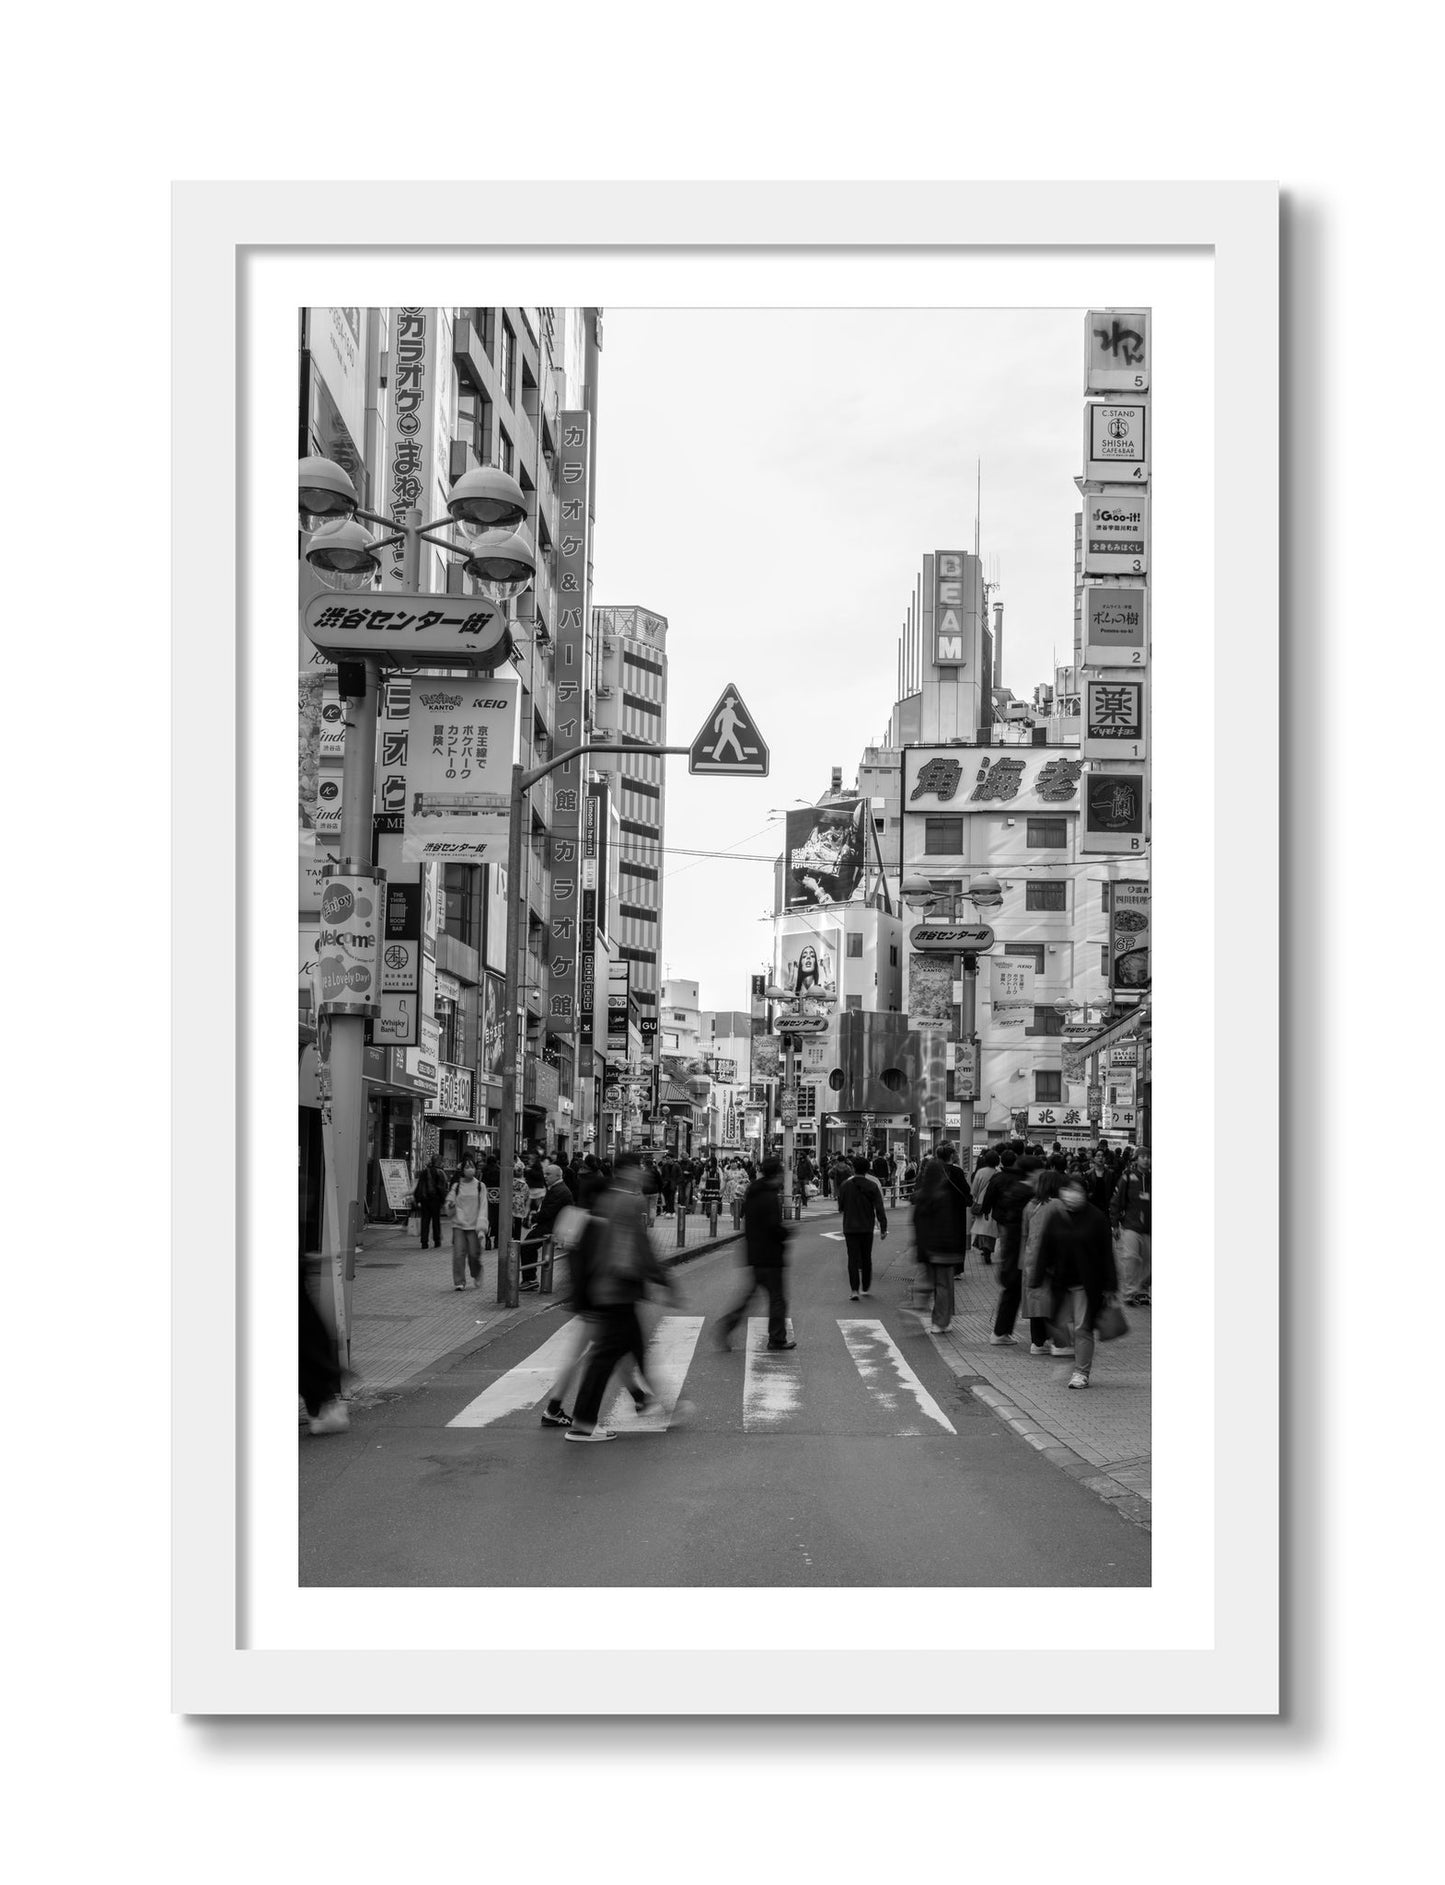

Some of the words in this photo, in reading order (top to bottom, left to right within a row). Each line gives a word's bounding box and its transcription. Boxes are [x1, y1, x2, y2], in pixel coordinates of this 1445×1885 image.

[1134, 376, 1144, 386] 5
[1102, 439, 1134, 448] SHISHA
[1101, 510, 1140, 522] Goo-it!
[1093, 543, 1141, 551] 全身もみほぐし
[1132, 559, 1141, 571] 3
[938, 554, 963, 659] BEAM
[313, 606, 494, 635] 渋谷センター街
[1132, 651, 1141, 663] 2
[472, 698, 508, 709] KEIO
[1095, 687, 1132, 724] 薬
[432, 724, 445, 756] 冒険へ
[445, 724, 459, 779] カントーの
[476, 725, 488, 769] 京王線で
[1132, 744, 1138, 756] 1
[423, 842, 488, 853] 渋谷センター街
[1131, 838, 1140, 850] B
[323, 893, 352, 918] Enjoy
[914, 930, 990, 941] 渋谷センター街
[1114, 937, 1136, 952] 6F
[332, 971, 354, 986] Lovely
[380, 1025, 396, 1033] Bank
[381, 1017, 405, 1029] Whisky
[642, 1021, 657, 1030] GU
